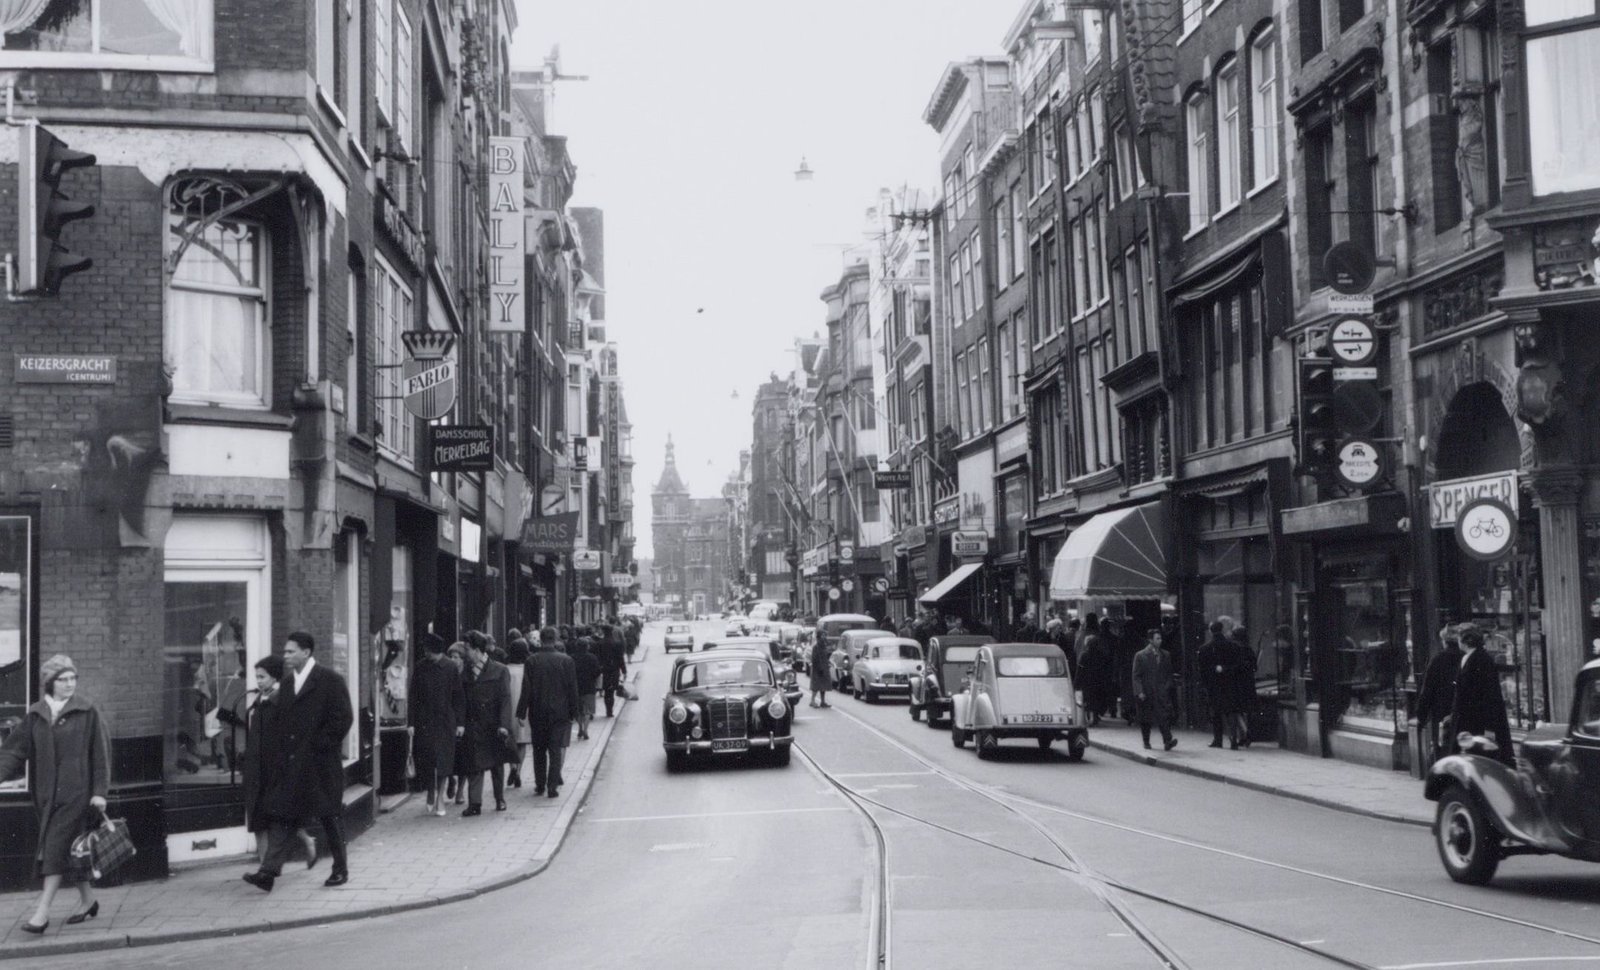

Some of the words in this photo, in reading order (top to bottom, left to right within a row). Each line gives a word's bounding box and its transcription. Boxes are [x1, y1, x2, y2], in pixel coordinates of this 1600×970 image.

[491, 145, 519, 322] BALLY
[20, 358, 110, 370] KEIZERSGRACHT
[409, 365, 450, 394] FABLO
[435, 429, 488, 439] DANSSCHOOL
[434, 440, 491, 465] MERKELBAG
[525, 523, 568, 539] MARS
